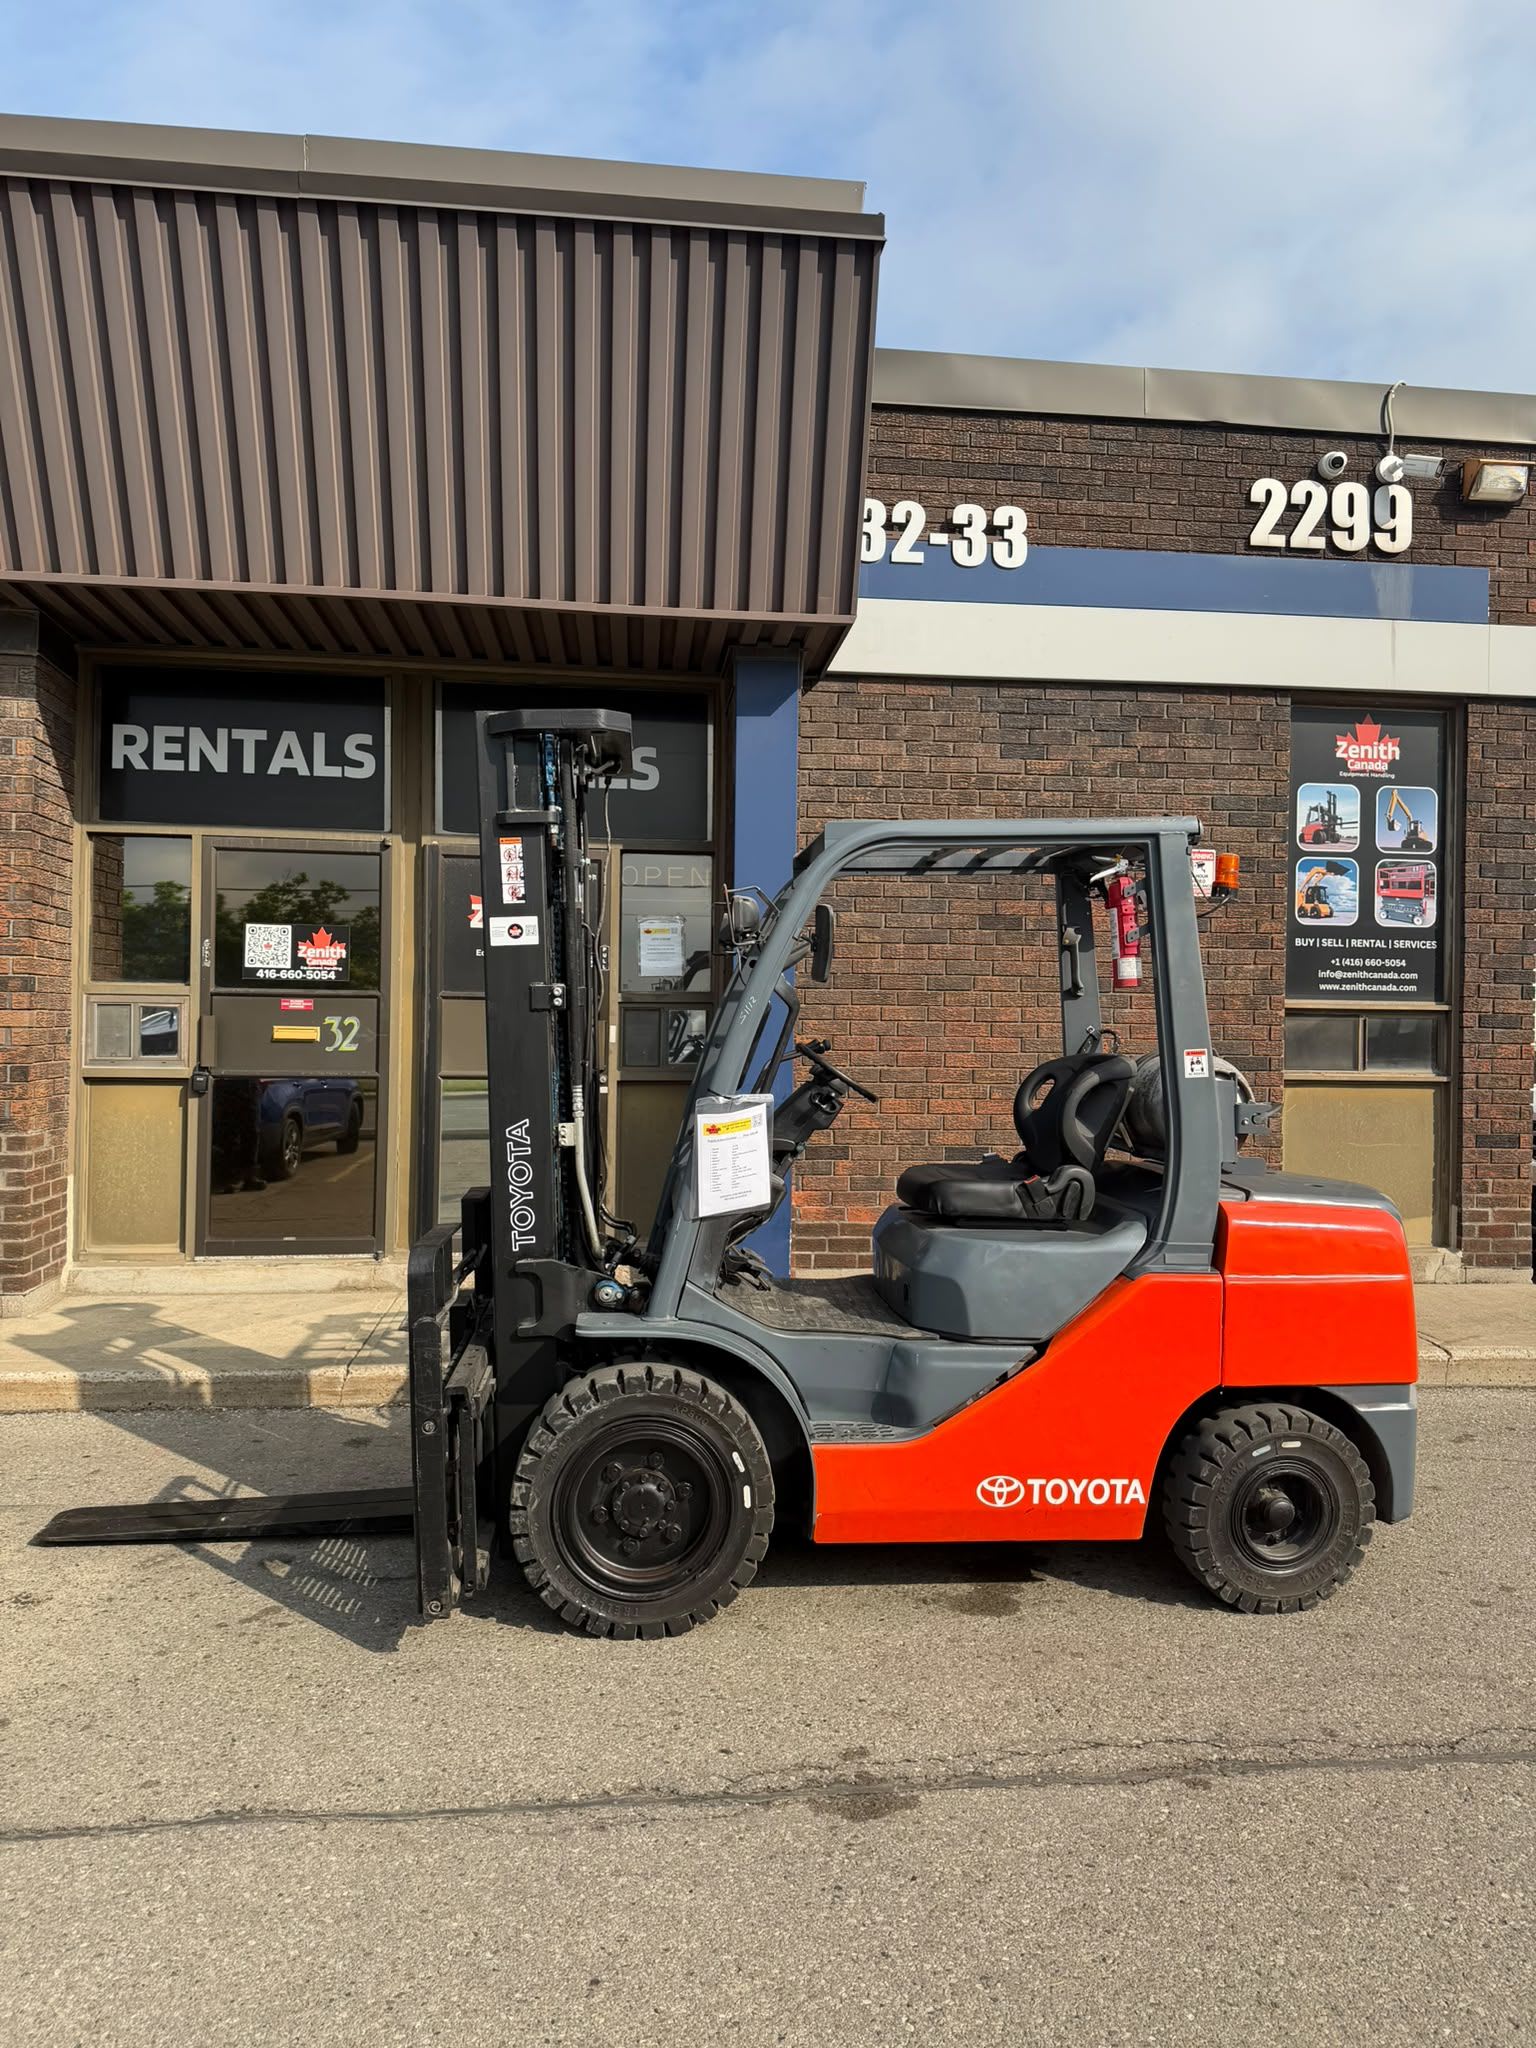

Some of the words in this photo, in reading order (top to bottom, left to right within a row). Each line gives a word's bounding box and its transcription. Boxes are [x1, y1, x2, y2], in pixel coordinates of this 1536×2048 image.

[1250, 478, 1412, 553] 2299
[861, 498, 1028, 568] 32-33
[111, 724, 376, 779] RENTALS
[1336, 741, 1400, 760] Zenith
[1347, 759, 1388, 771] Canada
[622, 866, 709, 887] OPEN
[297, 945, 346, 958] Zenith
[1295, 938, 1315, 947] BUY
[1322, 939, 1344, 947] SELL
[1351, 939, 1387, 948] RENTAL
[1393, 940, 1437, 949] SERVICES
[1331, 958, 1340, 966] +1
[1342, 958, 1363, 967] (416)
[1365, 959, 1406, 967] 660-5054
[256, 969, 336, 979] 416-660-5054
[1318, 970, 1418, 979] info@zenithcanada.com
[1319, 983, 1417, 992] www.zenithcanada.com
[323, 1016, 360, 1052] 32
[506, 1118, 536, 1252] TOYOTA
[1027, 1478, 1146, 1505] TOYOTA
